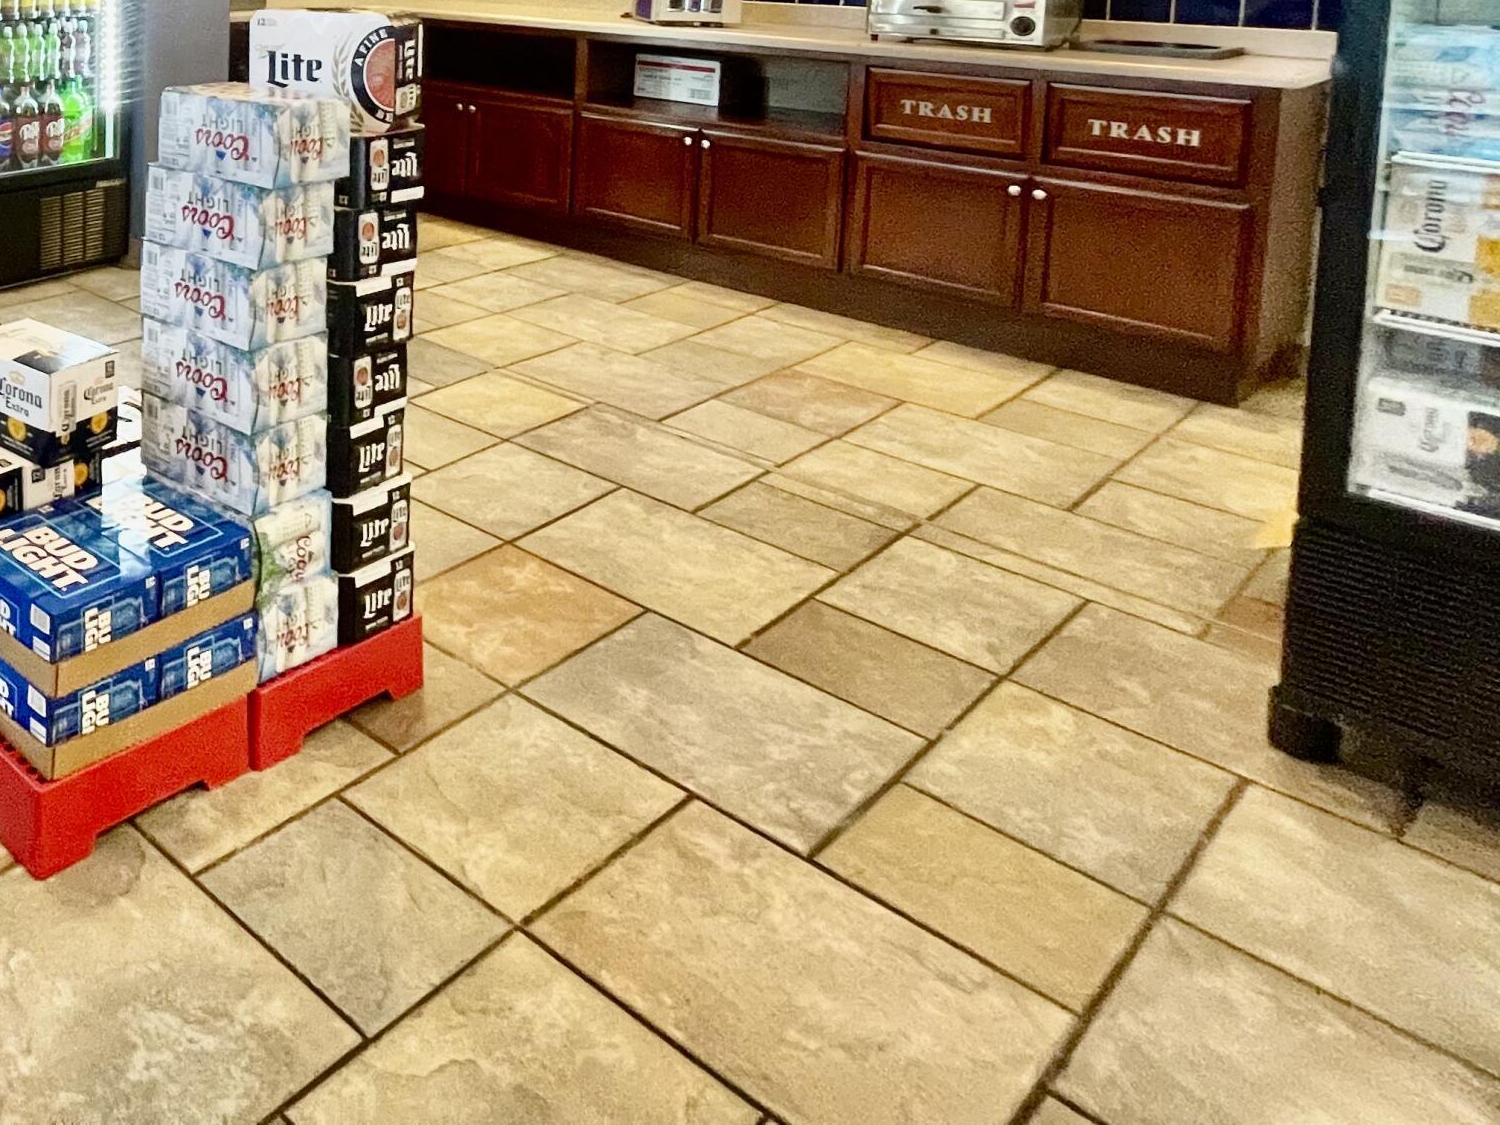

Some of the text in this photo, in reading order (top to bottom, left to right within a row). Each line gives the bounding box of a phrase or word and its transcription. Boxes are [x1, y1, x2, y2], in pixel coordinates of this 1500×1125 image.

[266, 50, 323, 88] Lite
[200, 112, 245, 133] LIGHT
[901, 99, 992, 123] TRASH
[195, 128, 249, 161] Coors
[1087, 119, 1199, 147] TRASH
[391, 152, 418, 178] Lite
[187, 190, 231, 213] LIGHT
[181, 205, 235, 241] Coors
[1414, 179, 1448, 254] Corona
[382, 224, 409, 250] Lite
[180, 268, 221, 292] LIGHT
[174, 281, 226, 319] Coors
[364, 303, 393, 332] Lite
[181, 349, 223, 373] LIGHT
[83, 382, 114, 401] Corona
[176, 360, 229, 403] Coors
[375, 364, 400, 392] Lite
[5, 397, 30, 418] Extra
[181, 425, 224, 453] LIGHT
[175, 438, 229, 483] Coors
[359, 442, 385, 473] Lite
[360, 518, 389, 547] Lite
[21, 525, 99, 572] BUD
[364, 587, 392, 619] Lite
